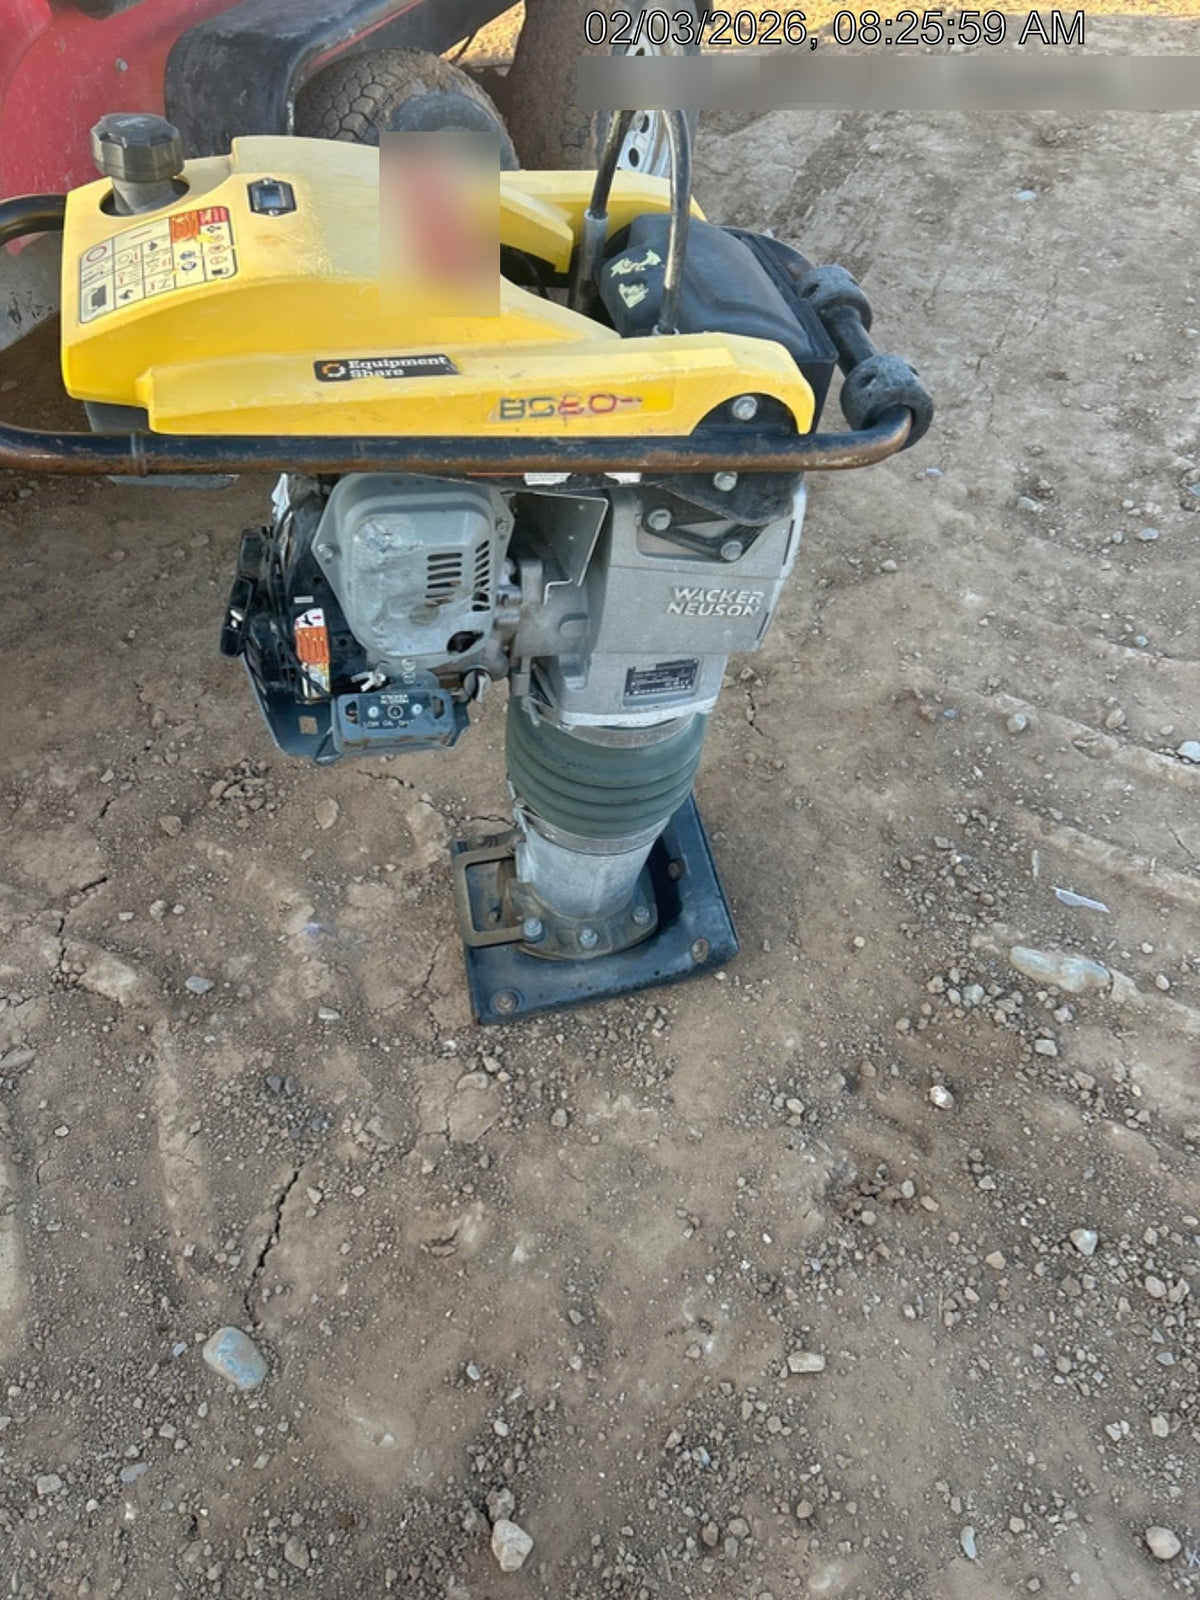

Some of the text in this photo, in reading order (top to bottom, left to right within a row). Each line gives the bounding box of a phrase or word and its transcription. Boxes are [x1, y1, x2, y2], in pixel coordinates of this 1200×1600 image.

[348, 356, 447, 370] Equipment
[350, 367, 404, 378] Share
[673, 587, 765, 605] WACKER
[666, 601, 759, 616] NEUSON
